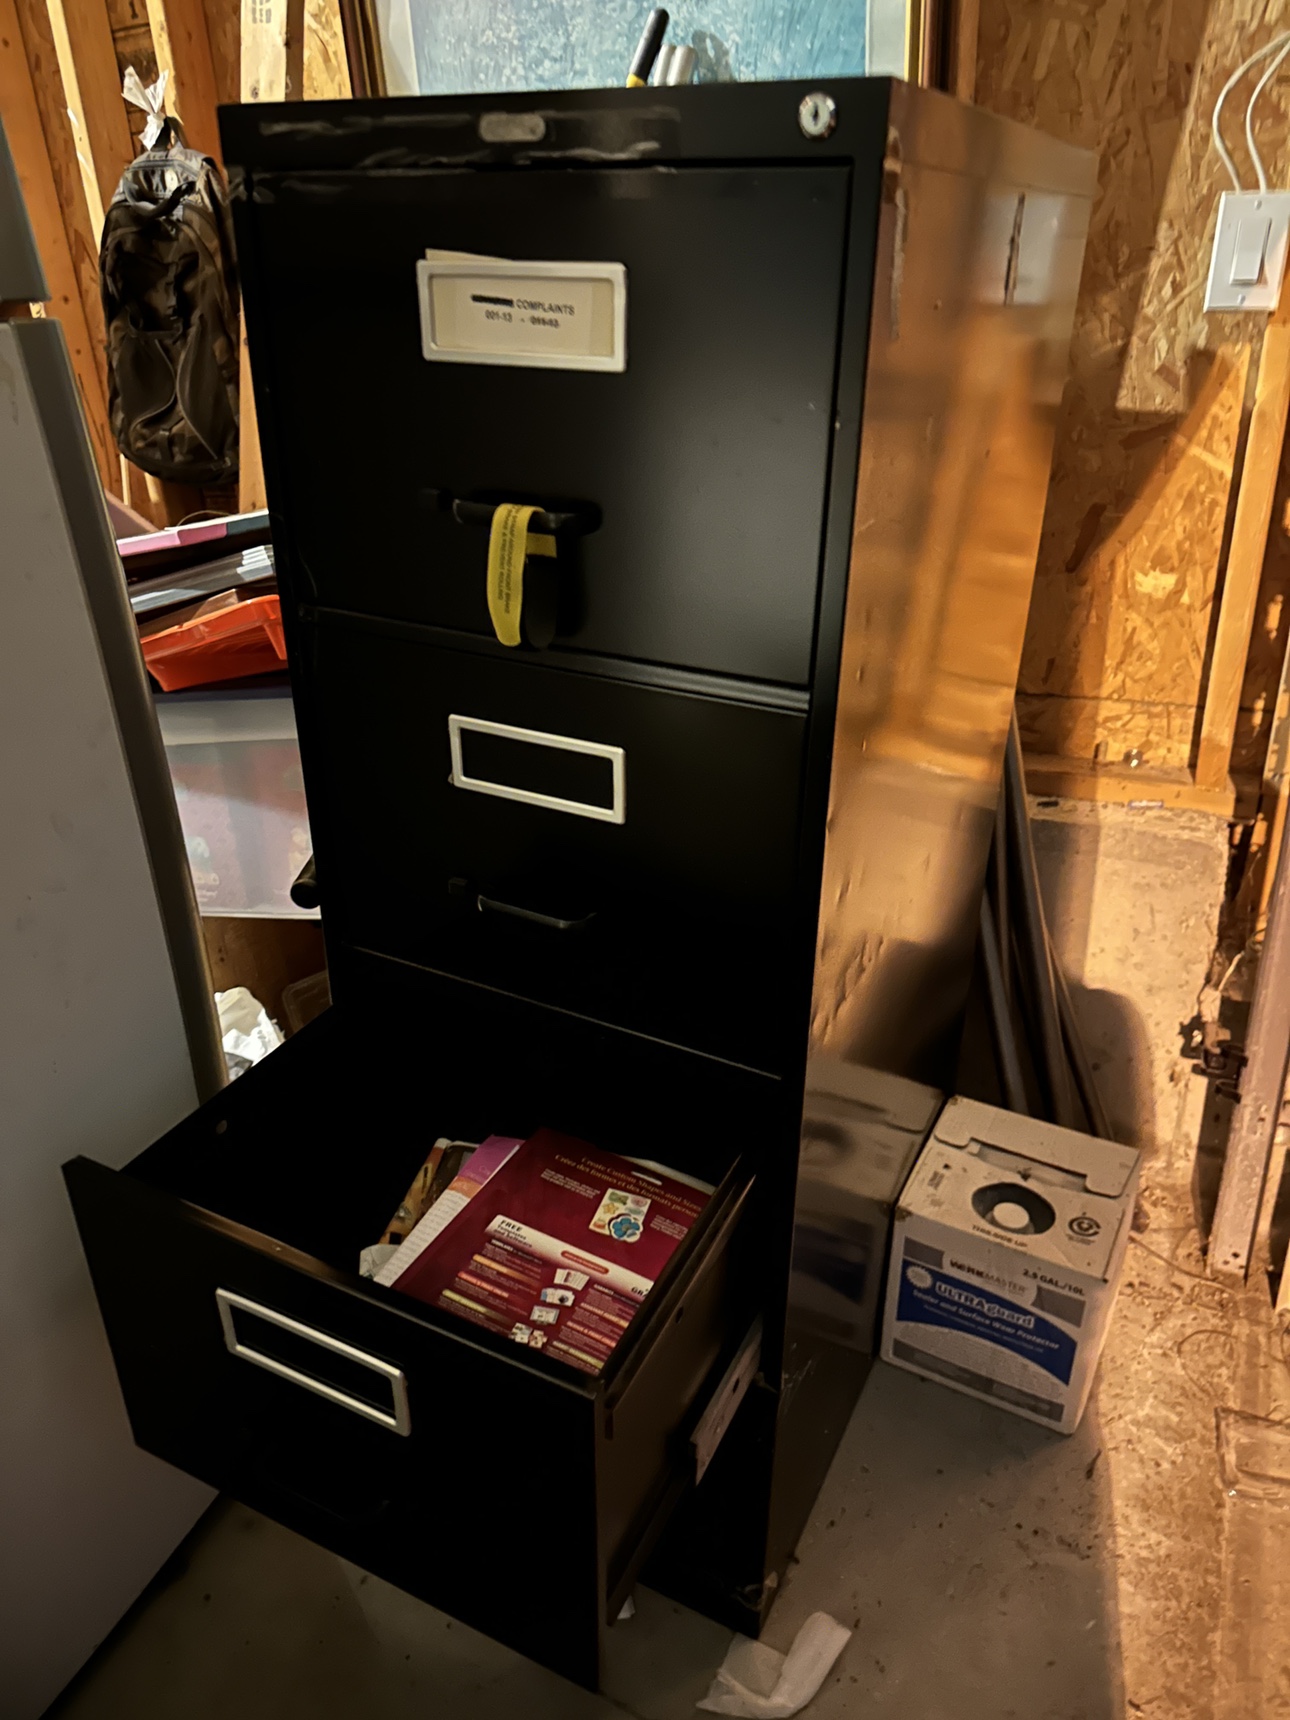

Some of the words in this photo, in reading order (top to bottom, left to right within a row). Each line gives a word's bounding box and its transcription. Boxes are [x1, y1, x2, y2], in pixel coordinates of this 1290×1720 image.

[516, 298, 575, 316] COMPLAINTS
[576, 1163, 590, 1173] des
[590, 1168, 617, 1184] formes
[617, 1179, 626, 1187] et
[626, 1183, 640, 1193] des
[640, 1189, 672, 1207] formats
[581, 1156, 607, 1171] Create
[606, 1165, 637, 1183] Custom
[639, 1179, 665, 1197] Shapes
[665, 1192, 682, 1203] and
[500, 1219, 523, 1233] FREE
[972, 1224, 992, 1236] THIS
[993, 1231, 1014, 1243] SIDE
[1014, 1239, 1028, 1248] UP
[950, 1260, 1026, 1293] WERKMASTER
[1022, 1268, 1038, 1279] 2.5
[913, 1288, 939, 1304] Sealer
[939, 1301, 958, 1312] and
[958, 1307, 991, 1325] Surface
[991, 1321, 1016, 1334] Wear
[1016, 1329, 1060, 1350] Protector
[935, 1280, 1035, 1329] ULTRAguard
